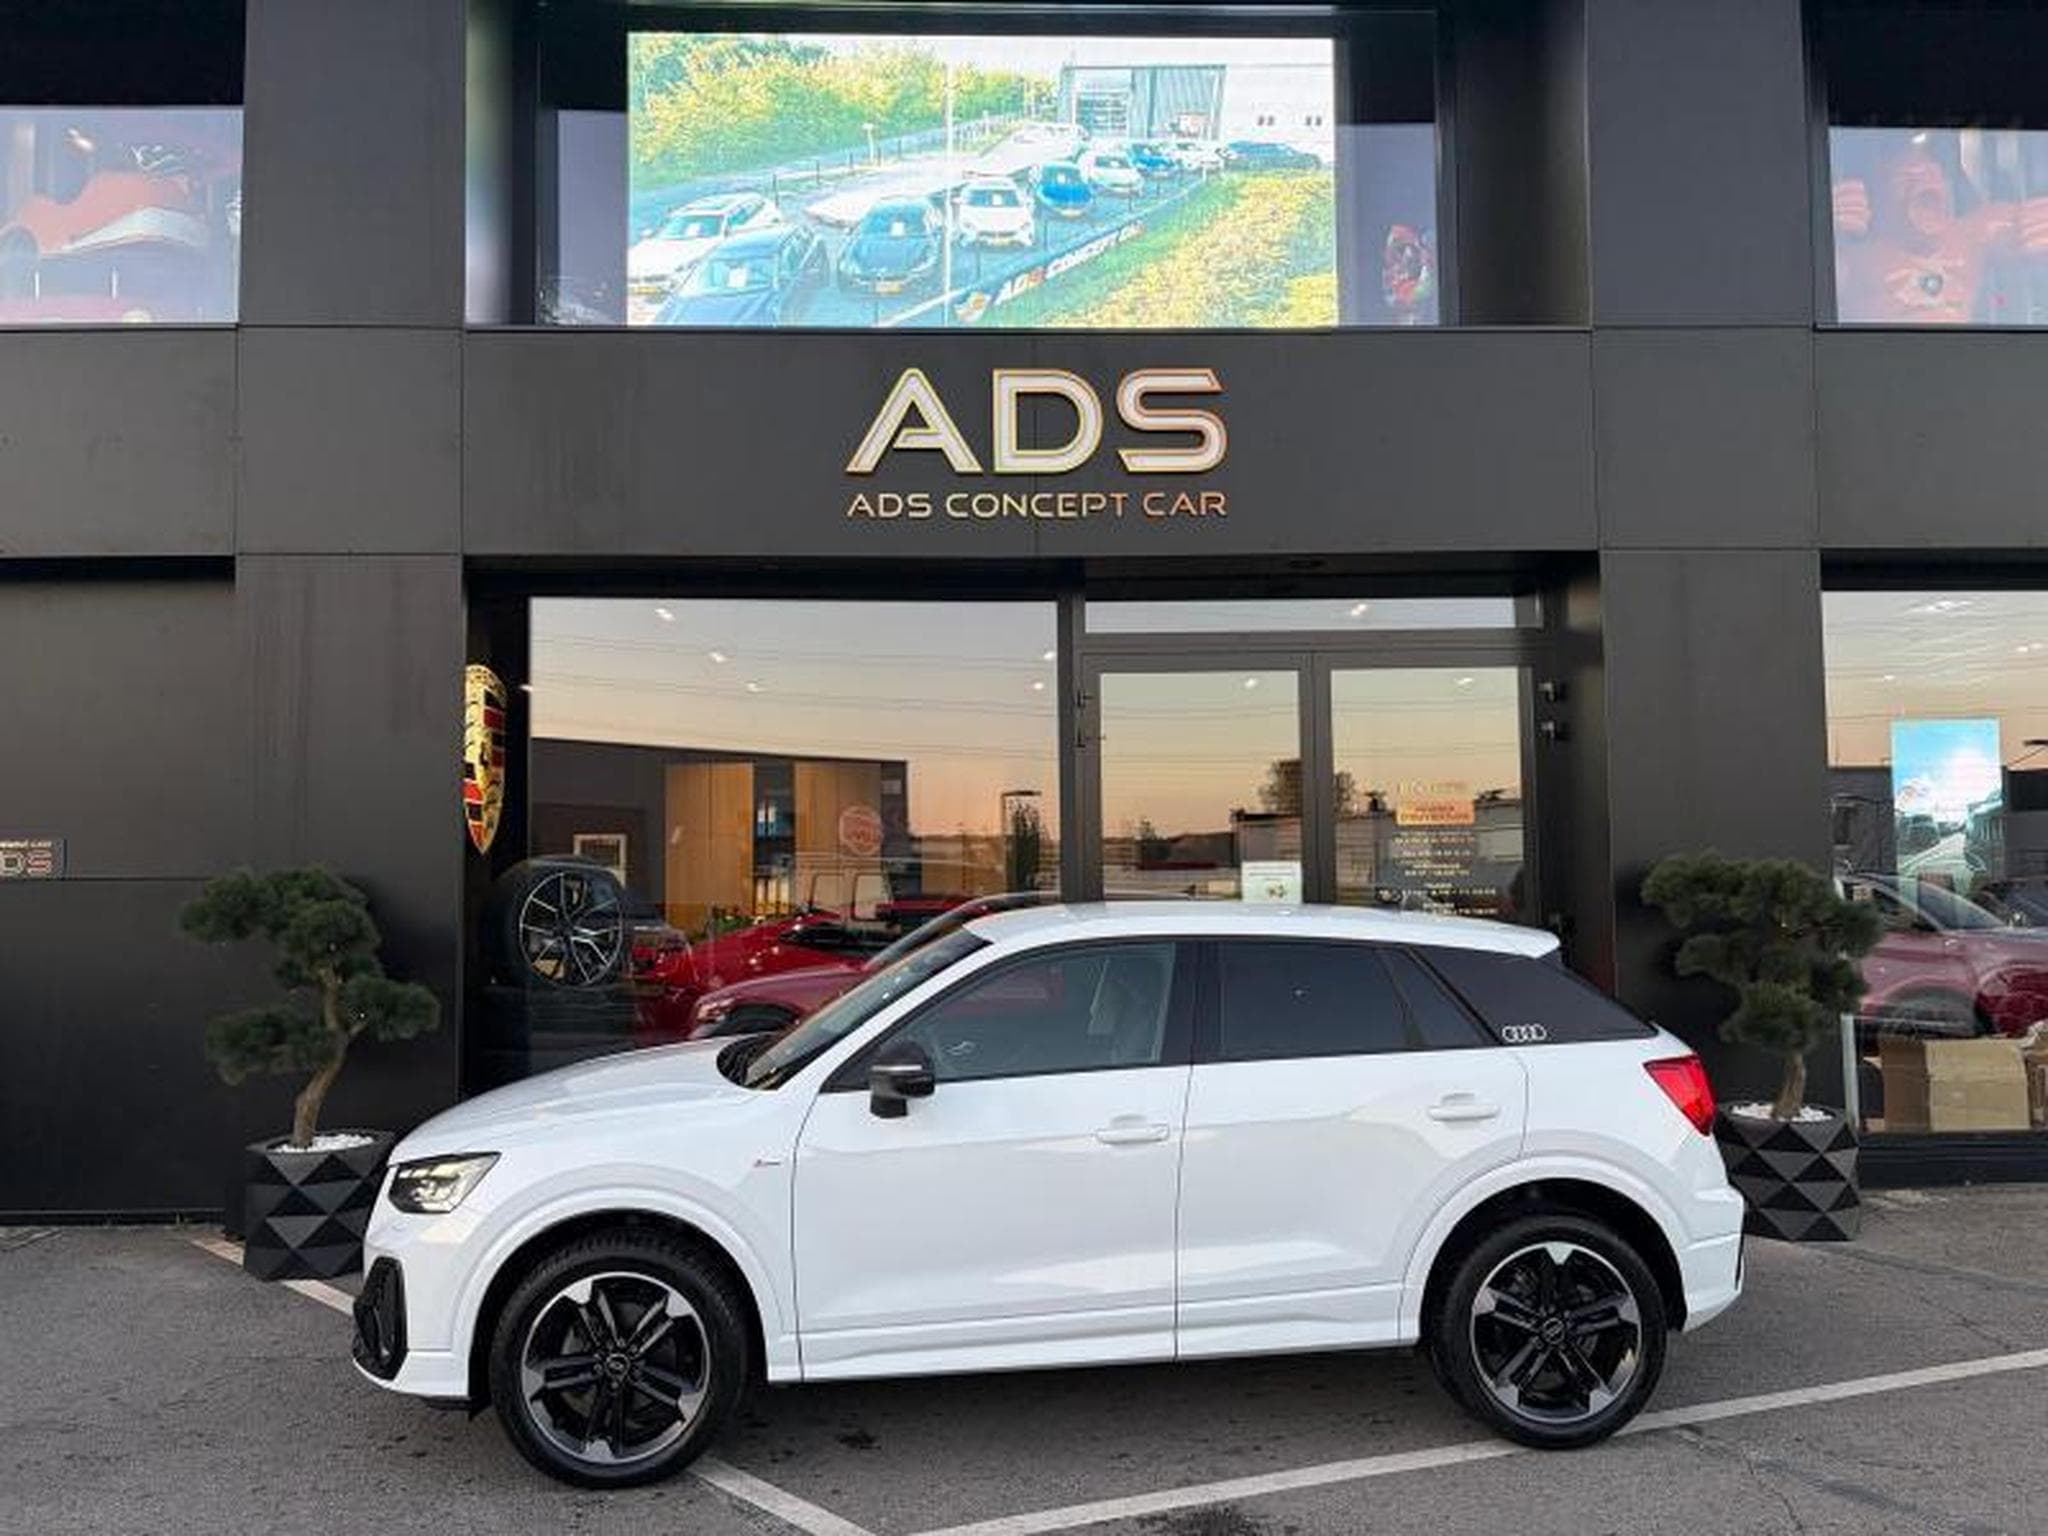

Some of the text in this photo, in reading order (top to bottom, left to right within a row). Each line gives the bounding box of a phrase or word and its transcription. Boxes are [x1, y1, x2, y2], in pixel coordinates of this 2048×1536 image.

[846, 367, 1229, 473] ADS
[847, 492, 1228, 519] ADS CONCEPT CAR
